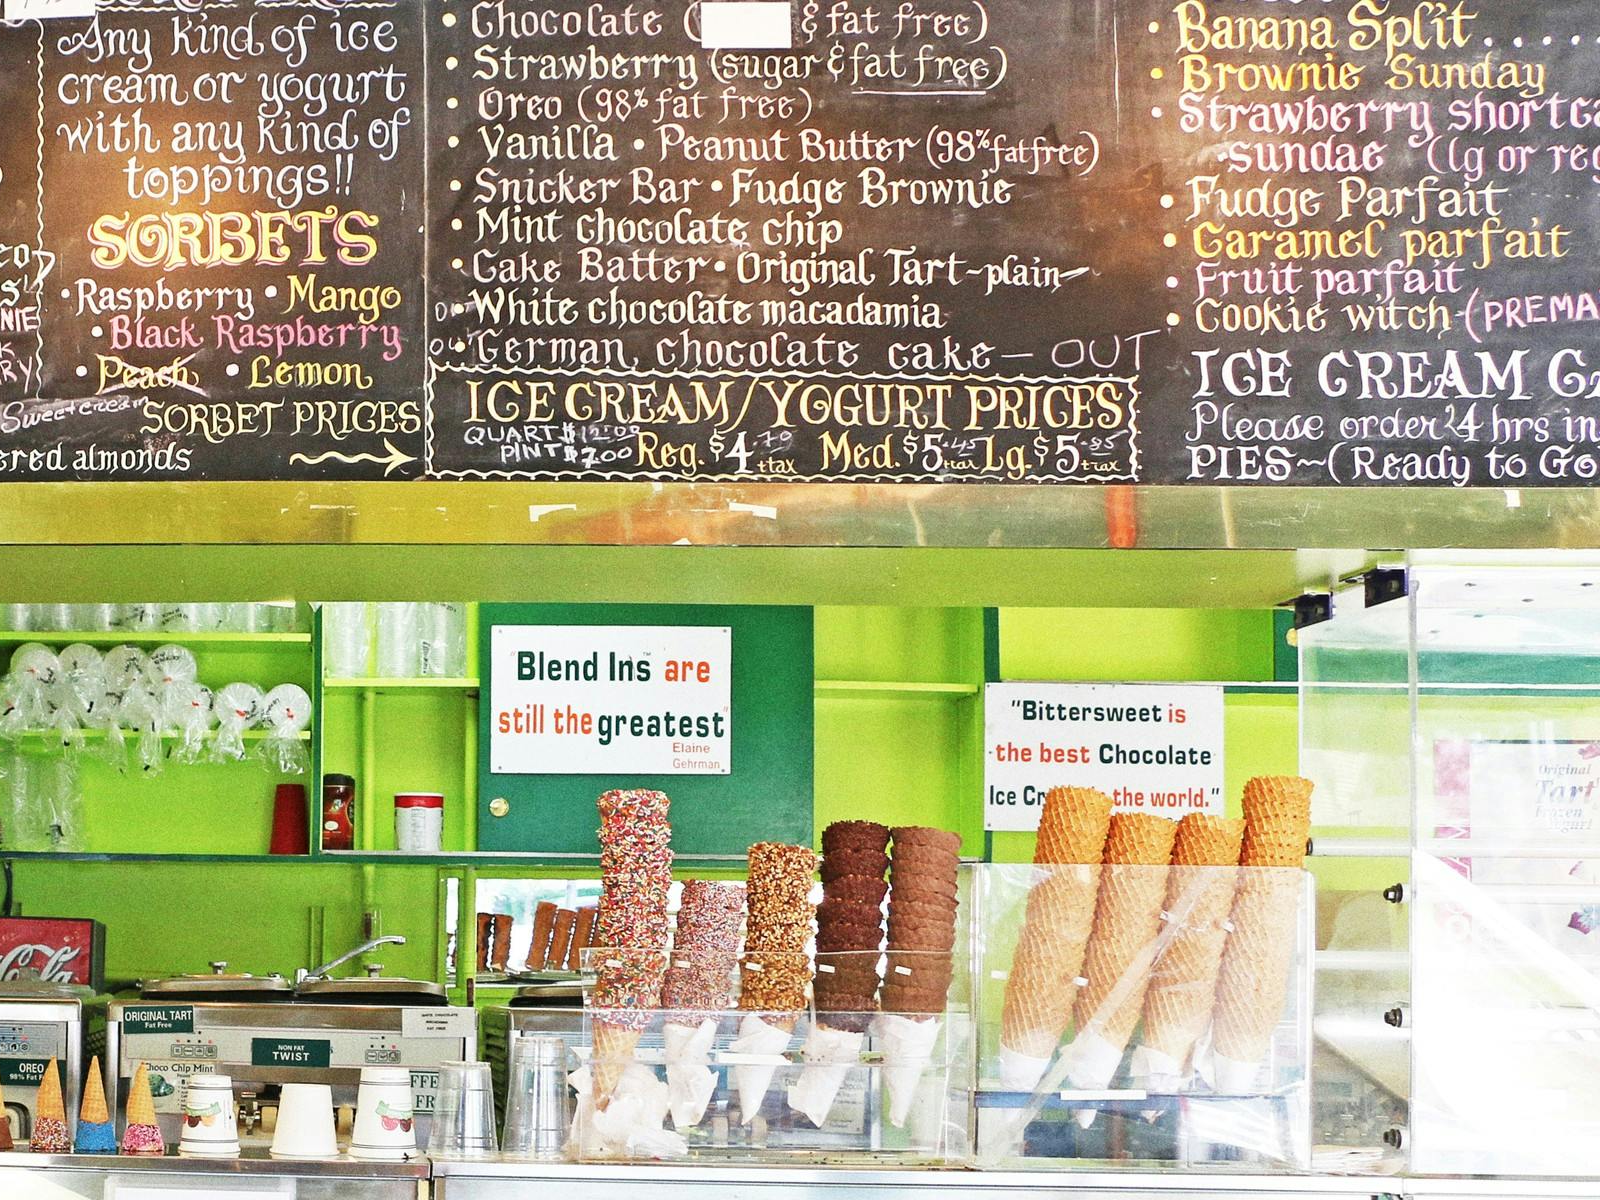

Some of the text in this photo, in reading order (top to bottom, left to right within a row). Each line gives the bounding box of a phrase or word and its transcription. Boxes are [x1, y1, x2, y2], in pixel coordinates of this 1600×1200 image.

[57, 11, 398, 72] Any kind of ice
[57, 68, 407, 118] cream or yogurt
[477, 88, 562, 122] Oreo
[654, 89, 705, 122] fat
[57, 108, 161, 154] with
[172, 119, 246, 164] any
[368, 109, 410, 160] of
[88, 205, 379, 270] SORBETS
[74, 274, 402, 324] Raspberry Mango
[1194, 296, 1327, 335] Cookie
[110, 314, 402, 360] Black Raspberry
[1052, 329, 1160, 372] OUT
[249, 356, 372, 390] Lemon
[1191, 348, 1531, 401] ICE CREAM
[464, 380, 555, 424] ICE
[964, 382, 1123, 430] PRICES
[140, 400, 421, 443] SORBET PRICES
[464, 426, 558, 445] QUART
[500, 443, 561, 464] PINT
[664, 660, 710, 683] are
[499, 704, 544, 734] still
[554, 705, 592, 734] the
[1168, 704, 1187, 723] is
[672, 743, 711, 753] Elaine
[672, 757, 720, 769] Gehrman
[995, 742, 1212, 765] the best Chocolate
[989, 785, 1017, 806] Ice
[1113, 787, 1144, 806] the
[125, 1010, 192, 1021] ORIGINAL TART
[19, 1063, 44, 1073] OREO
[193, 1064, 213, 1072] Mint
[272, 1052, 309, 1061] TWIST
